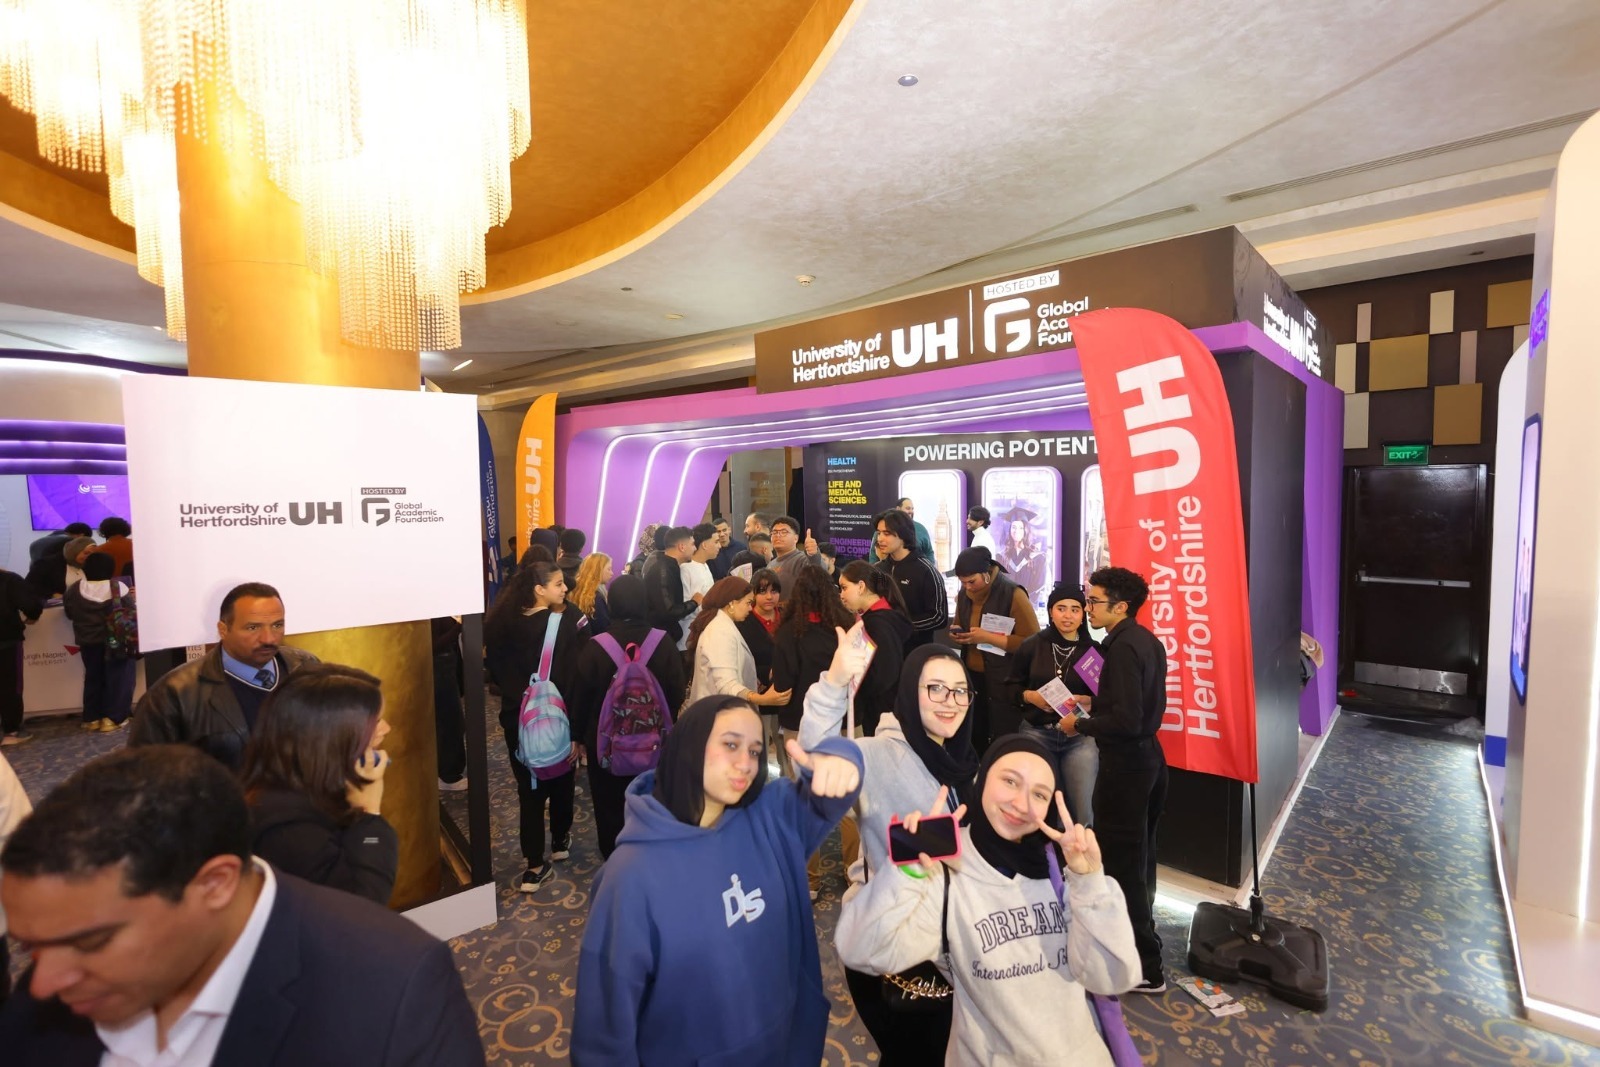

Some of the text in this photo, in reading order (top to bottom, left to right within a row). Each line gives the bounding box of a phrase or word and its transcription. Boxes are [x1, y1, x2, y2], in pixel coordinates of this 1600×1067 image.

[986, 273, 1056, 297] HOSTED BY
[1036, 296, 1089, 319] Global
[791, 332, 882, 366] University of
[891, 317, 959, 368] UH
[792, 353, 891, 383] Hertfordshire
[1115, 355, 1202, 496] UH
[903, 435, 1099, 462] POWERING POTENT
[1388, 451, 1412, 460] EXIT
[525, 437, 543, 495] UH
[827, 457, 857, 466] HEALTH
[828, 480, 862, 488] LIFE AND
[828, 488, 863, 496] MEDICAL
[179, 502, 279, 516] University of
[394, 502, 423, 510] Global
[828, 496, 867, 504] SCIENCES
[180, 515, 287, 528] Hertfordshire
[288, 501, 343, 526] UH
[394, 509, 438, 517] Academic
[395, 516, 444, 524] Foundation
[1139, 518, 1167, 552] of
[1172, 495, 1221, 740] Hertfordshire
[972, 953, 1045, 980] International
